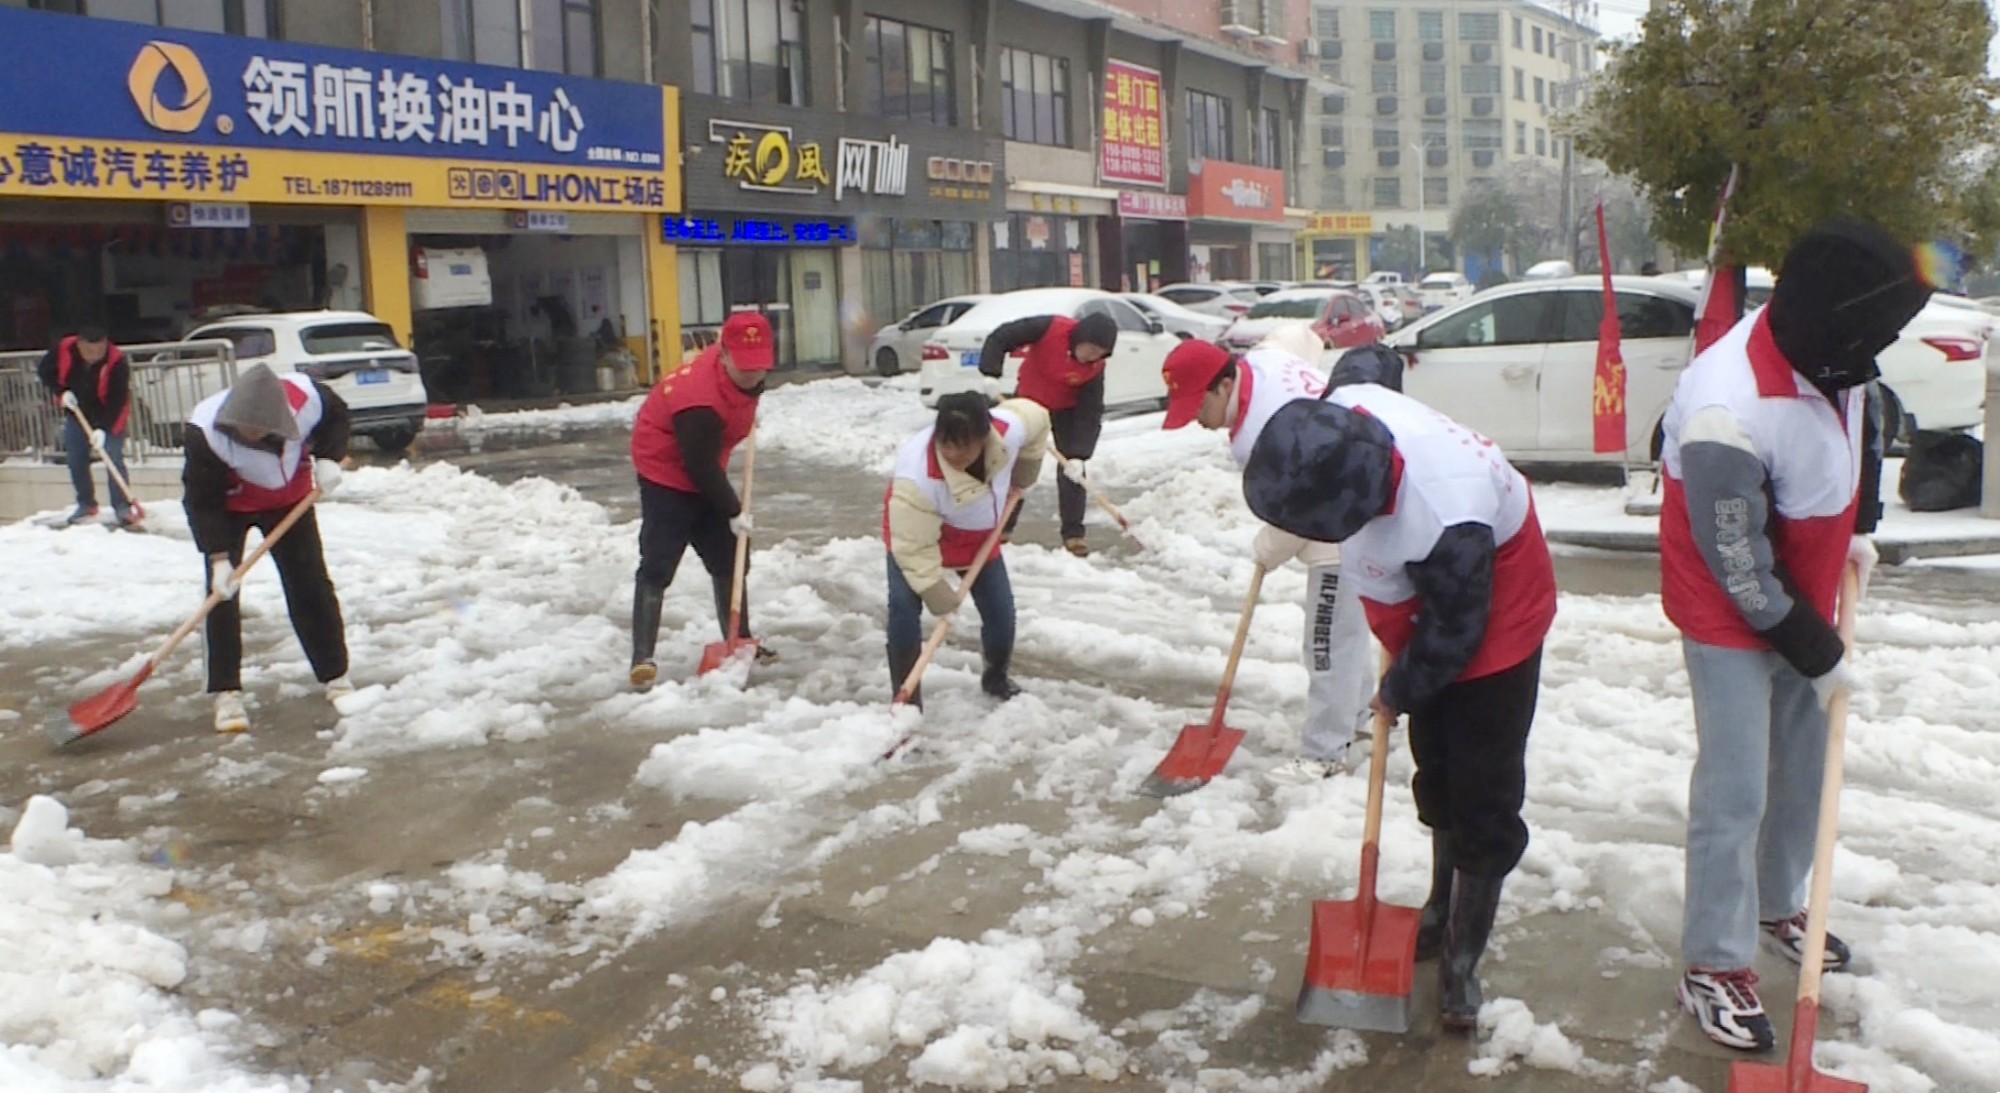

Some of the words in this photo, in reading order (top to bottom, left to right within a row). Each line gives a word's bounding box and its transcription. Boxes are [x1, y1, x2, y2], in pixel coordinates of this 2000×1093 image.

[242, 56, 585, 152] 领航换油中心
[1104, 72, 1159, 112] 二楼门面
[1104, 107, 1161, 148] 整体出租
[282, 176, 413, 197] TEL:18711289111
[520, 173, 665, 206] LIHON工场店
